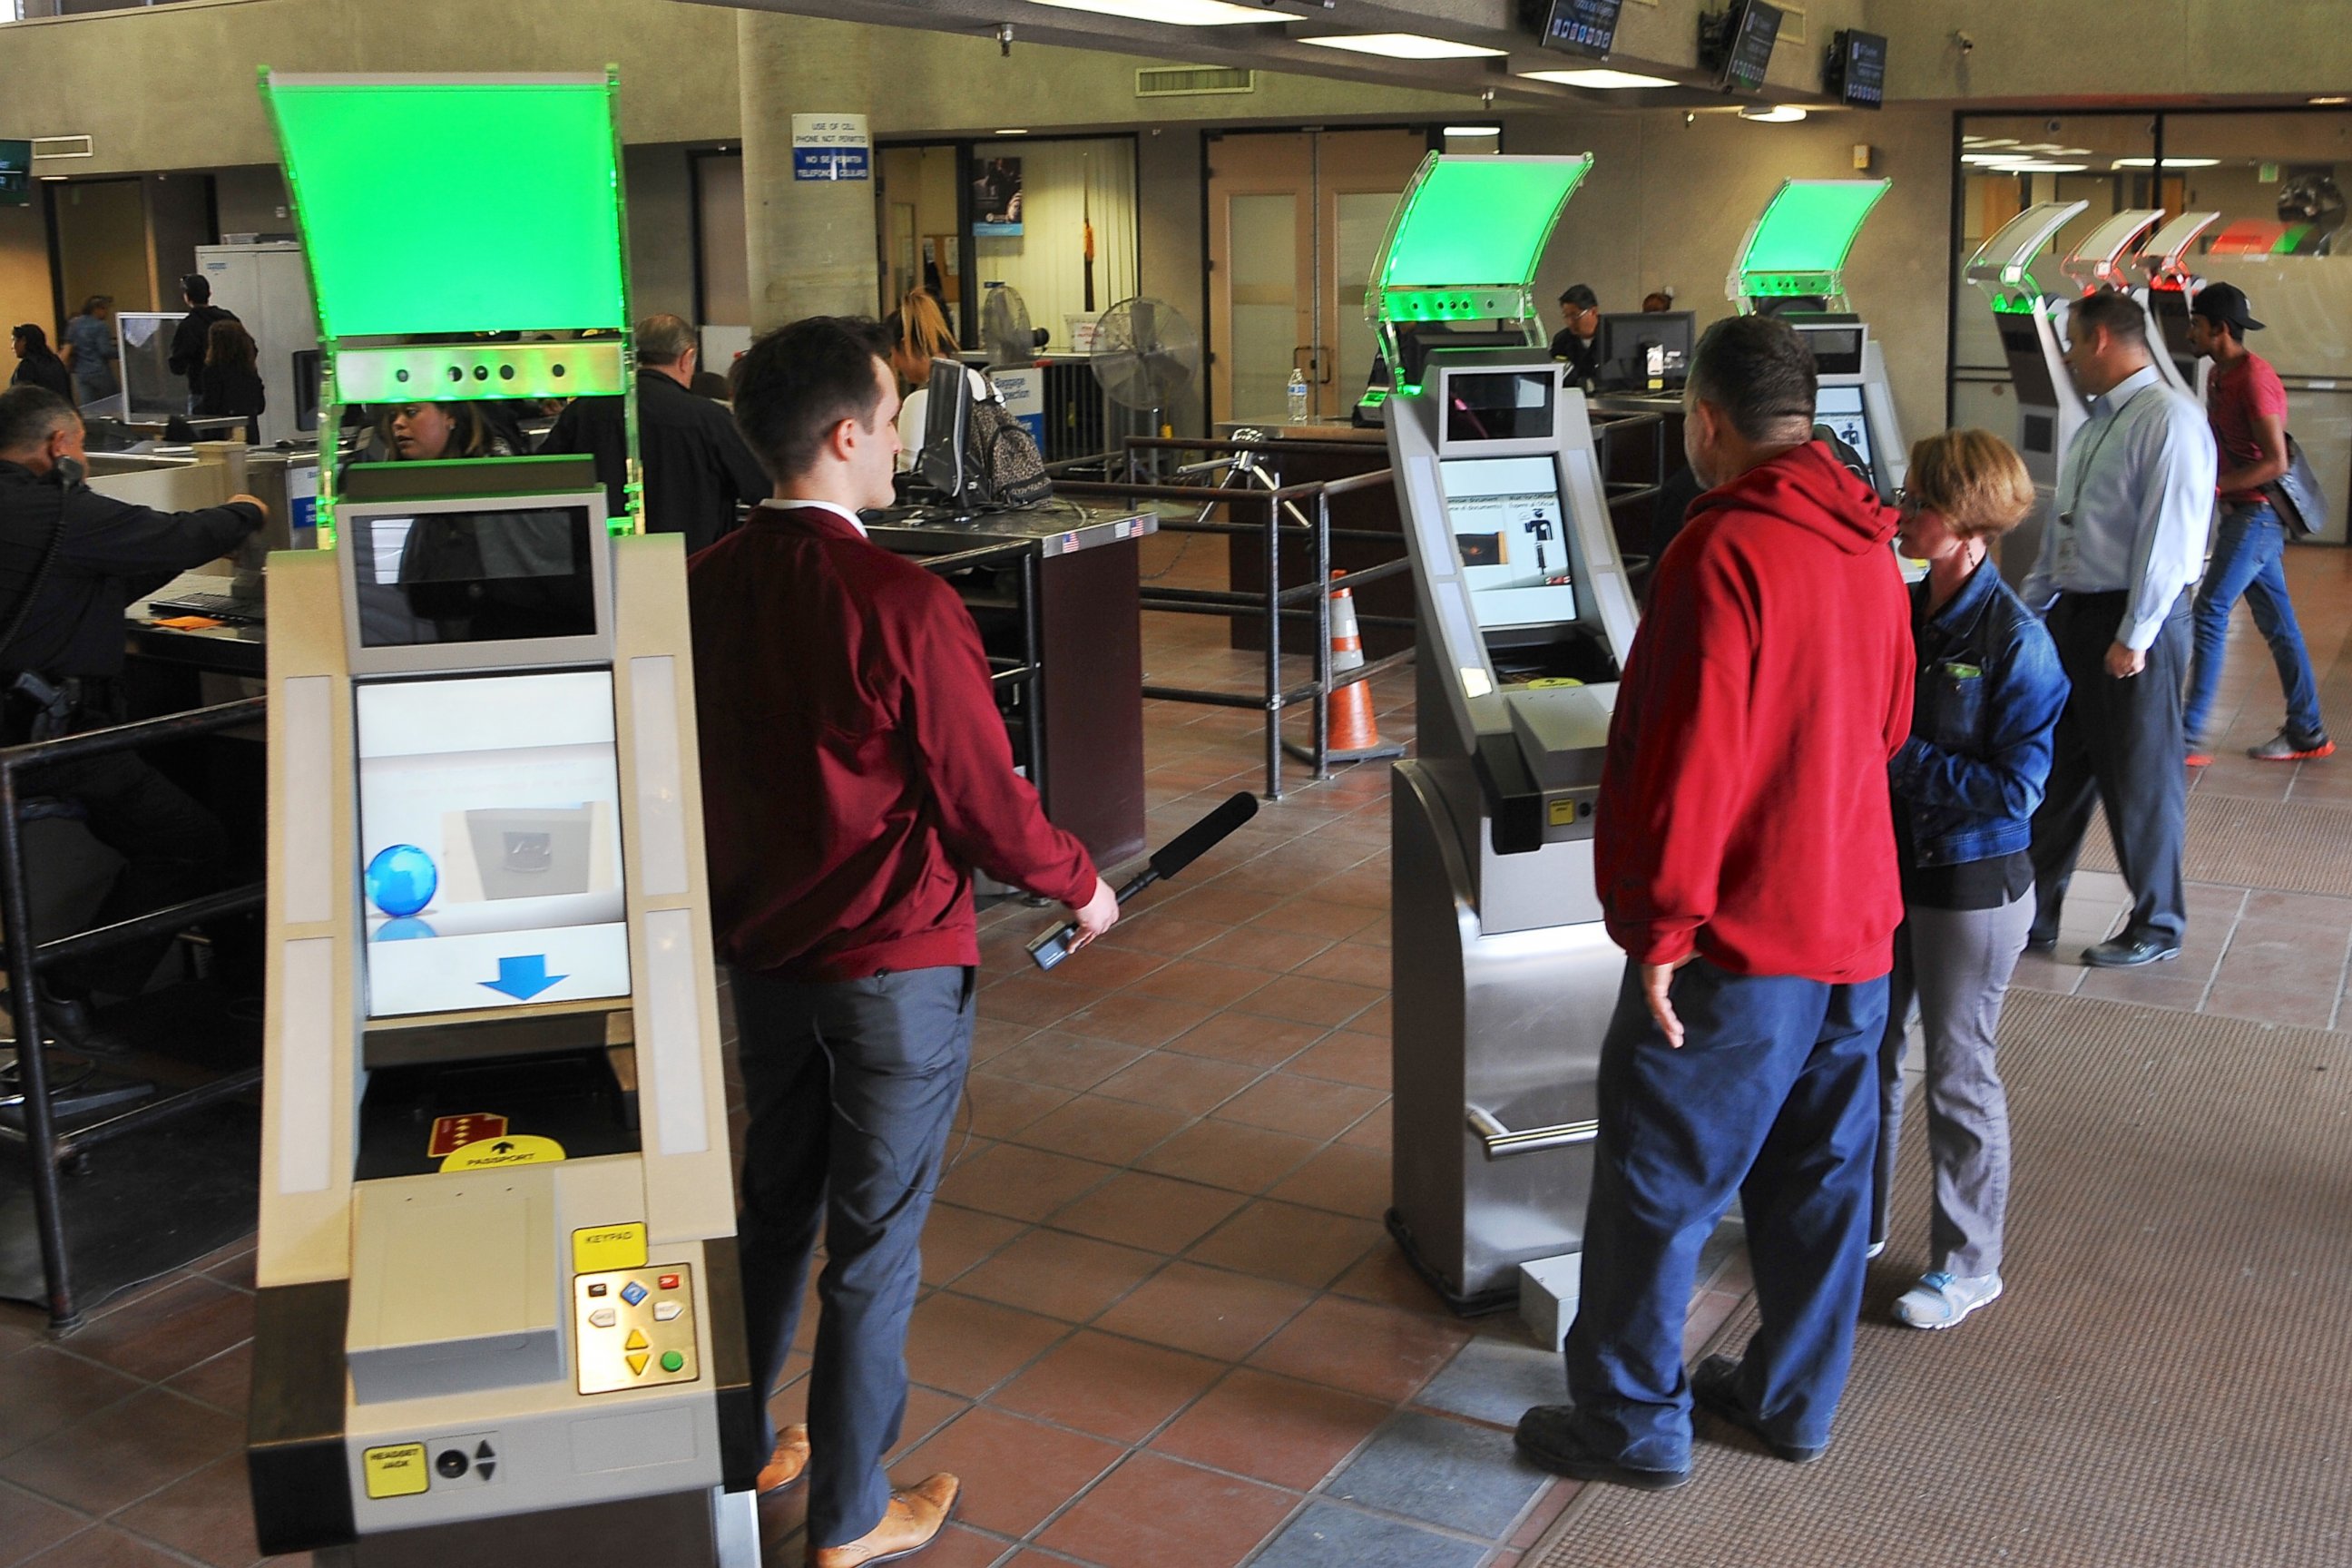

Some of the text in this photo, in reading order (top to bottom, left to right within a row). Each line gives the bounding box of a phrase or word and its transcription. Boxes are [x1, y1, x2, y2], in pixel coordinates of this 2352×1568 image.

[812, 122, 855, 131] USE OF CELL
[795, 135, 818, 143] PHONE
[805, 155, 818, 164] NO
[466, 1152, 536, 1166] PASSPORT
[584, 1230, 633, 1244] KEYPAD
[369, 1447, 420, 1461] HEADSET
[382, 1460, 409, 1470] JACK
